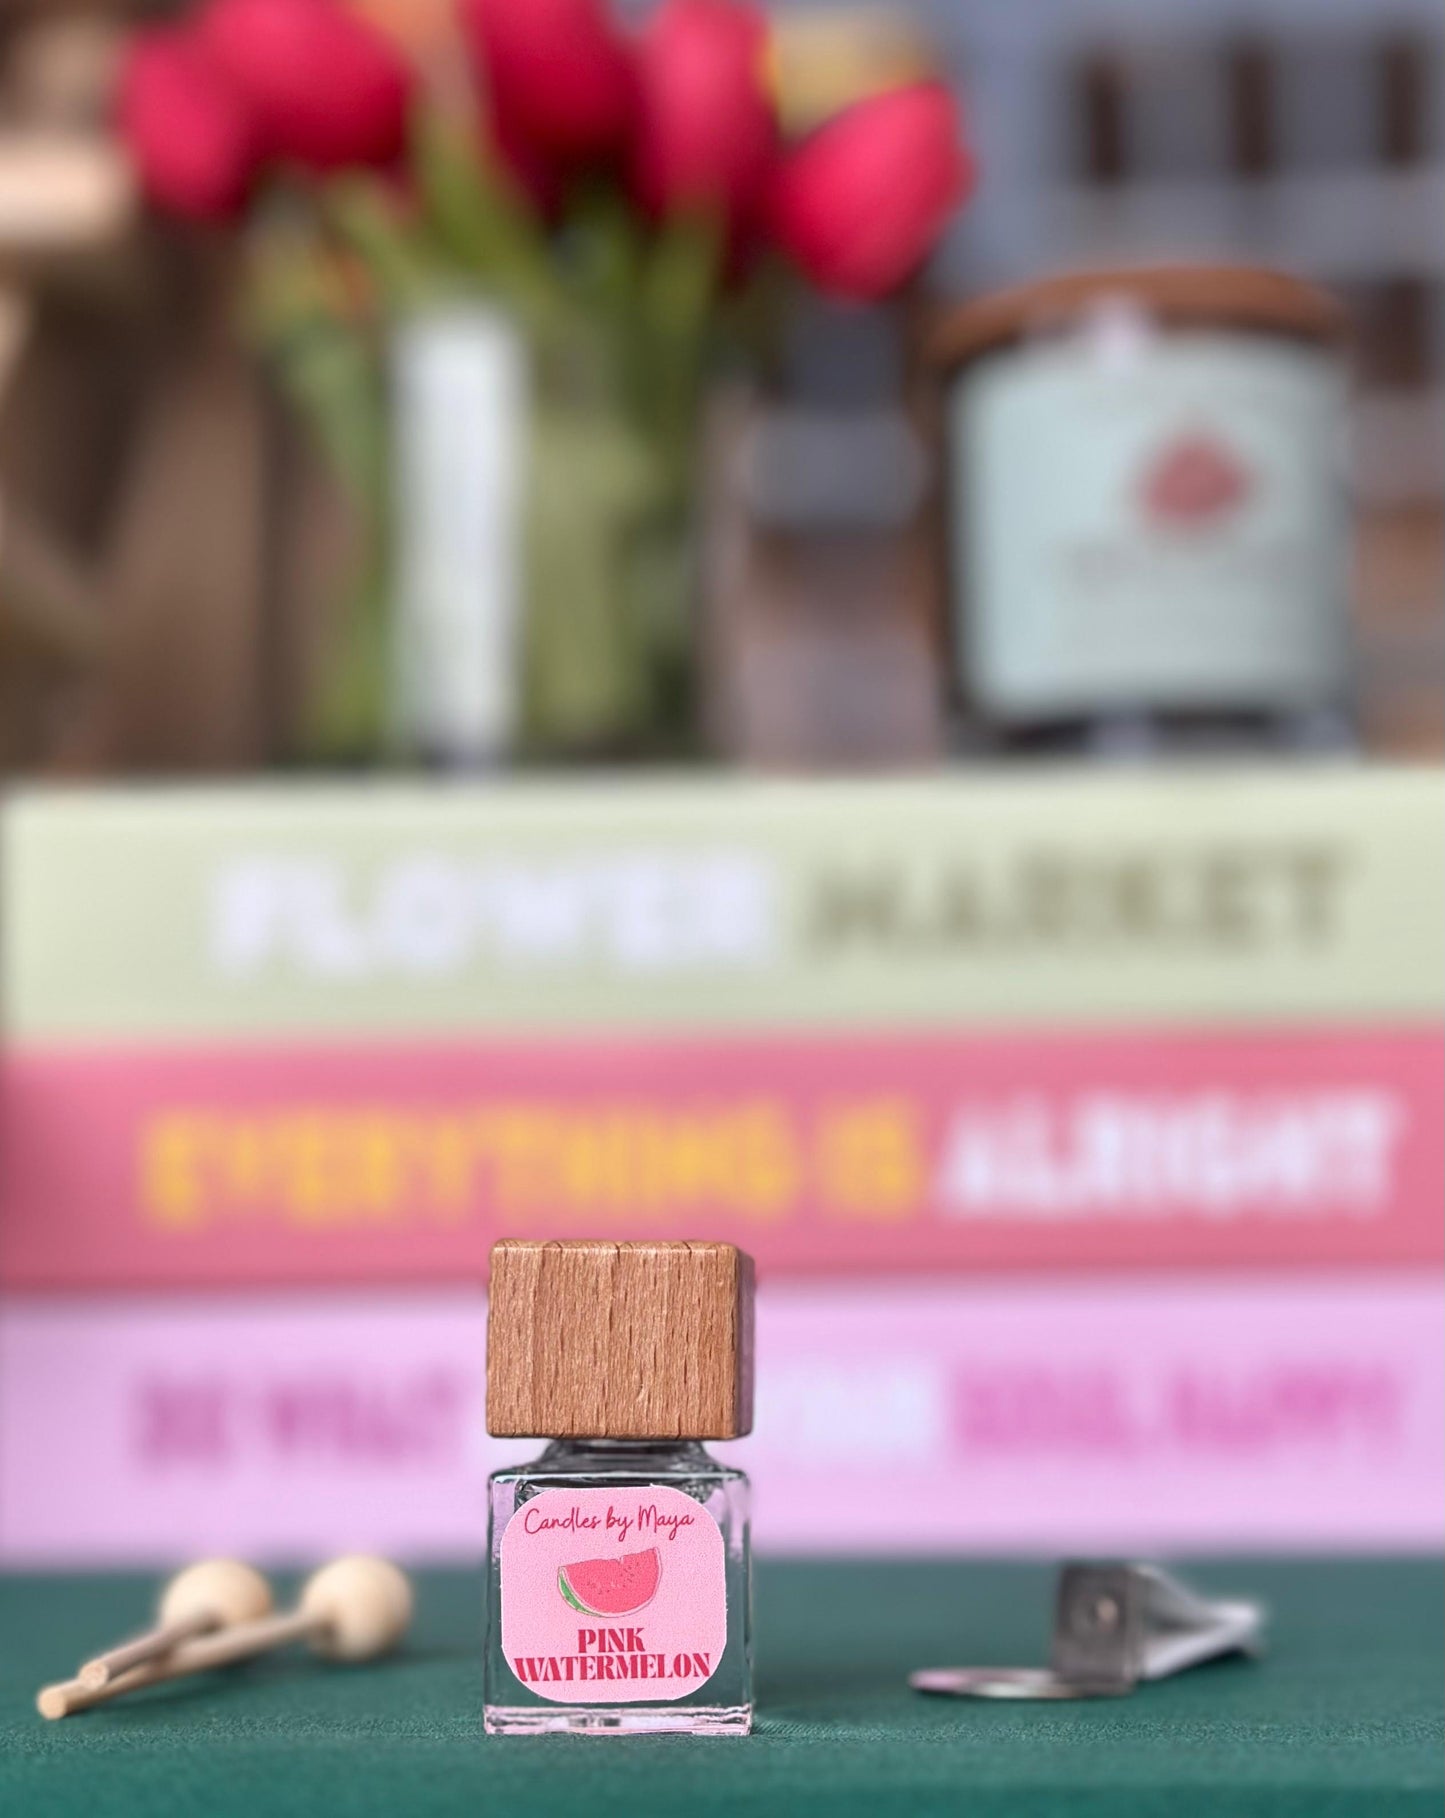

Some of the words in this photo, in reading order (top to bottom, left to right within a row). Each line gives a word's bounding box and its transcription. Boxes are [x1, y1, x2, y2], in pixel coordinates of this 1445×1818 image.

[524, 1507, 601, 1534] Candles
[606, 1505, 634, 1542] by
[638, 1504, 695, 1540] Maya
[577, 1627, 646, 1653] PINK
[514, 1653, 711, 1682] WATERMELON
